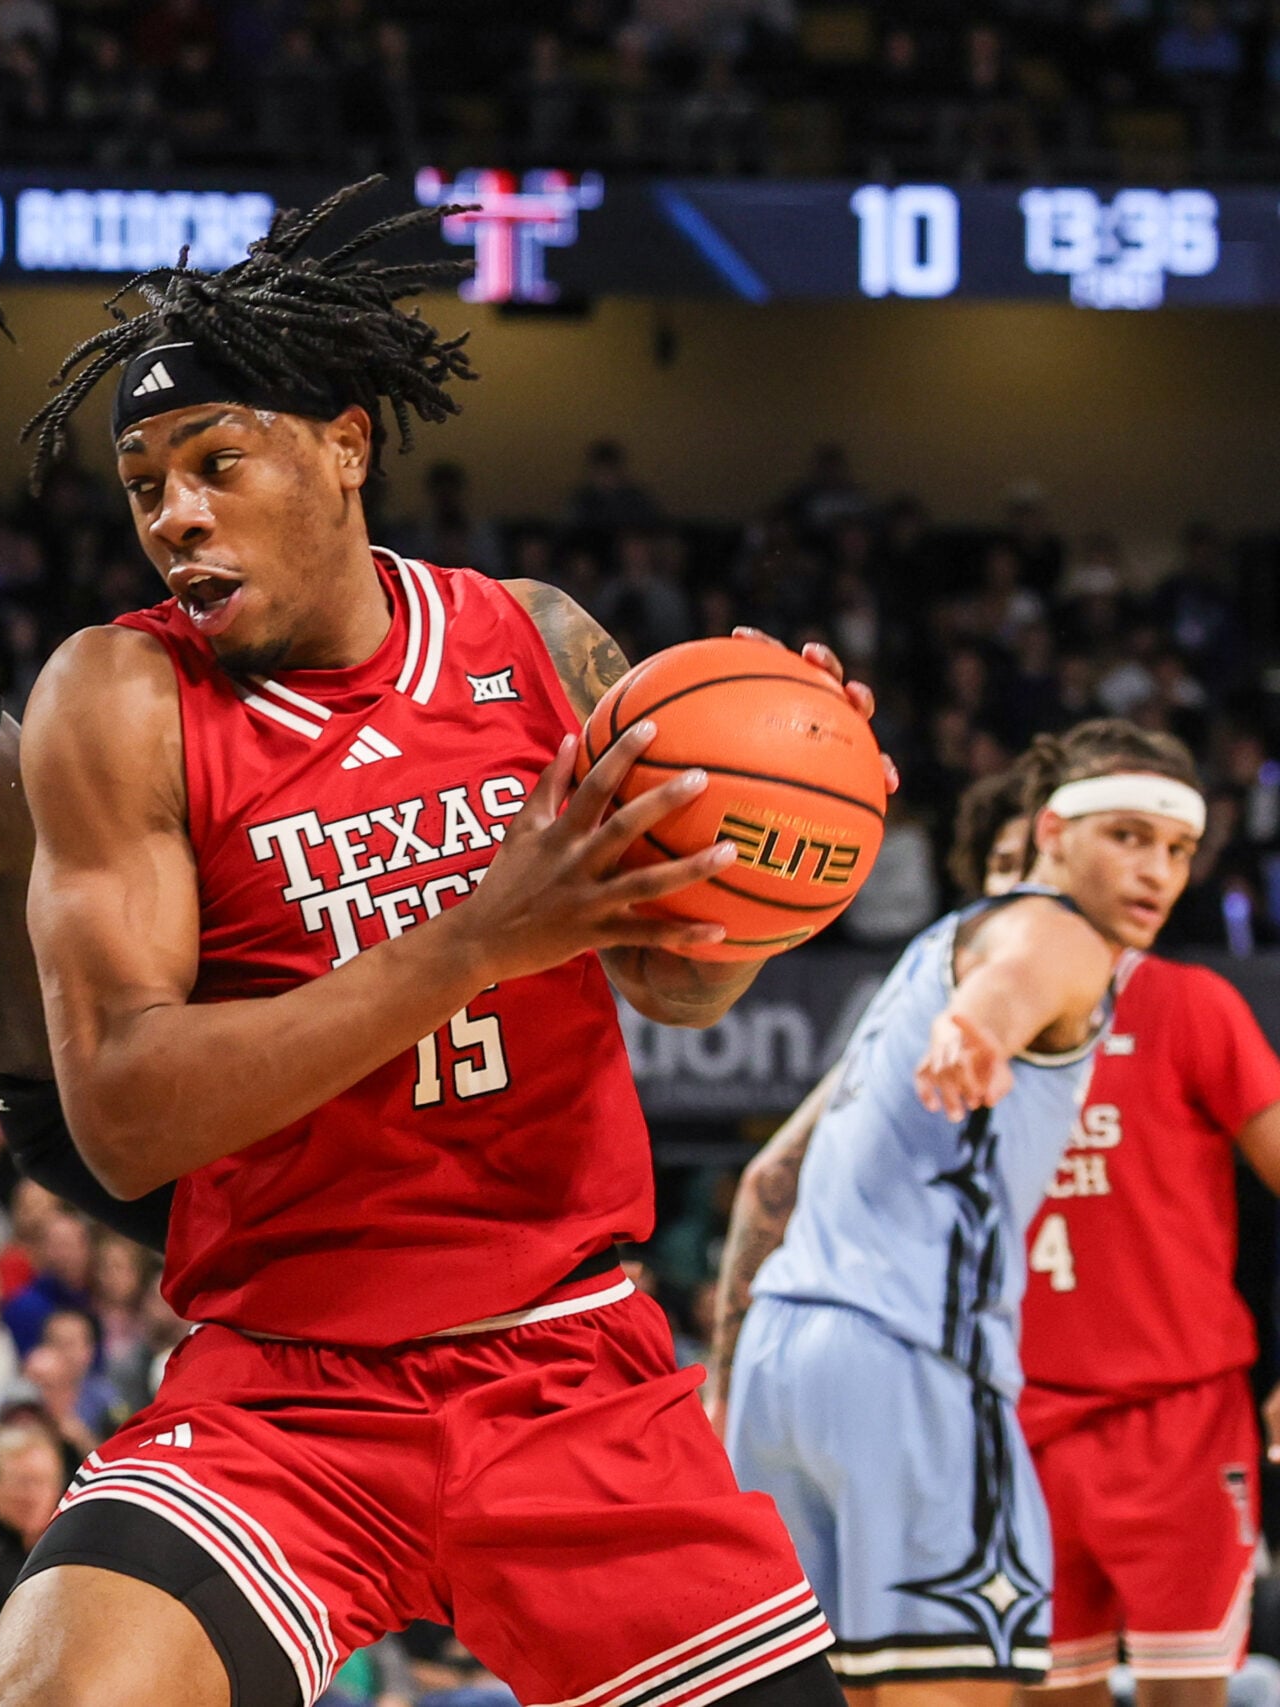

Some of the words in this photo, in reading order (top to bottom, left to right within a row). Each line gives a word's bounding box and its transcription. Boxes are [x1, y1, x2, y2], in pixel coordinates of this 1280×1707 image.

[850, 186, 959, 298] 10
[1020, 187, 1219, 276] 13:36
[465, 667, 522, 703] XII
[247, 775, 528, 902] TEXAS
[715, 812, 861, 888] ELITE
[299, 866, 489, 972] TEC
[413, 980, 511, 1112] 15
